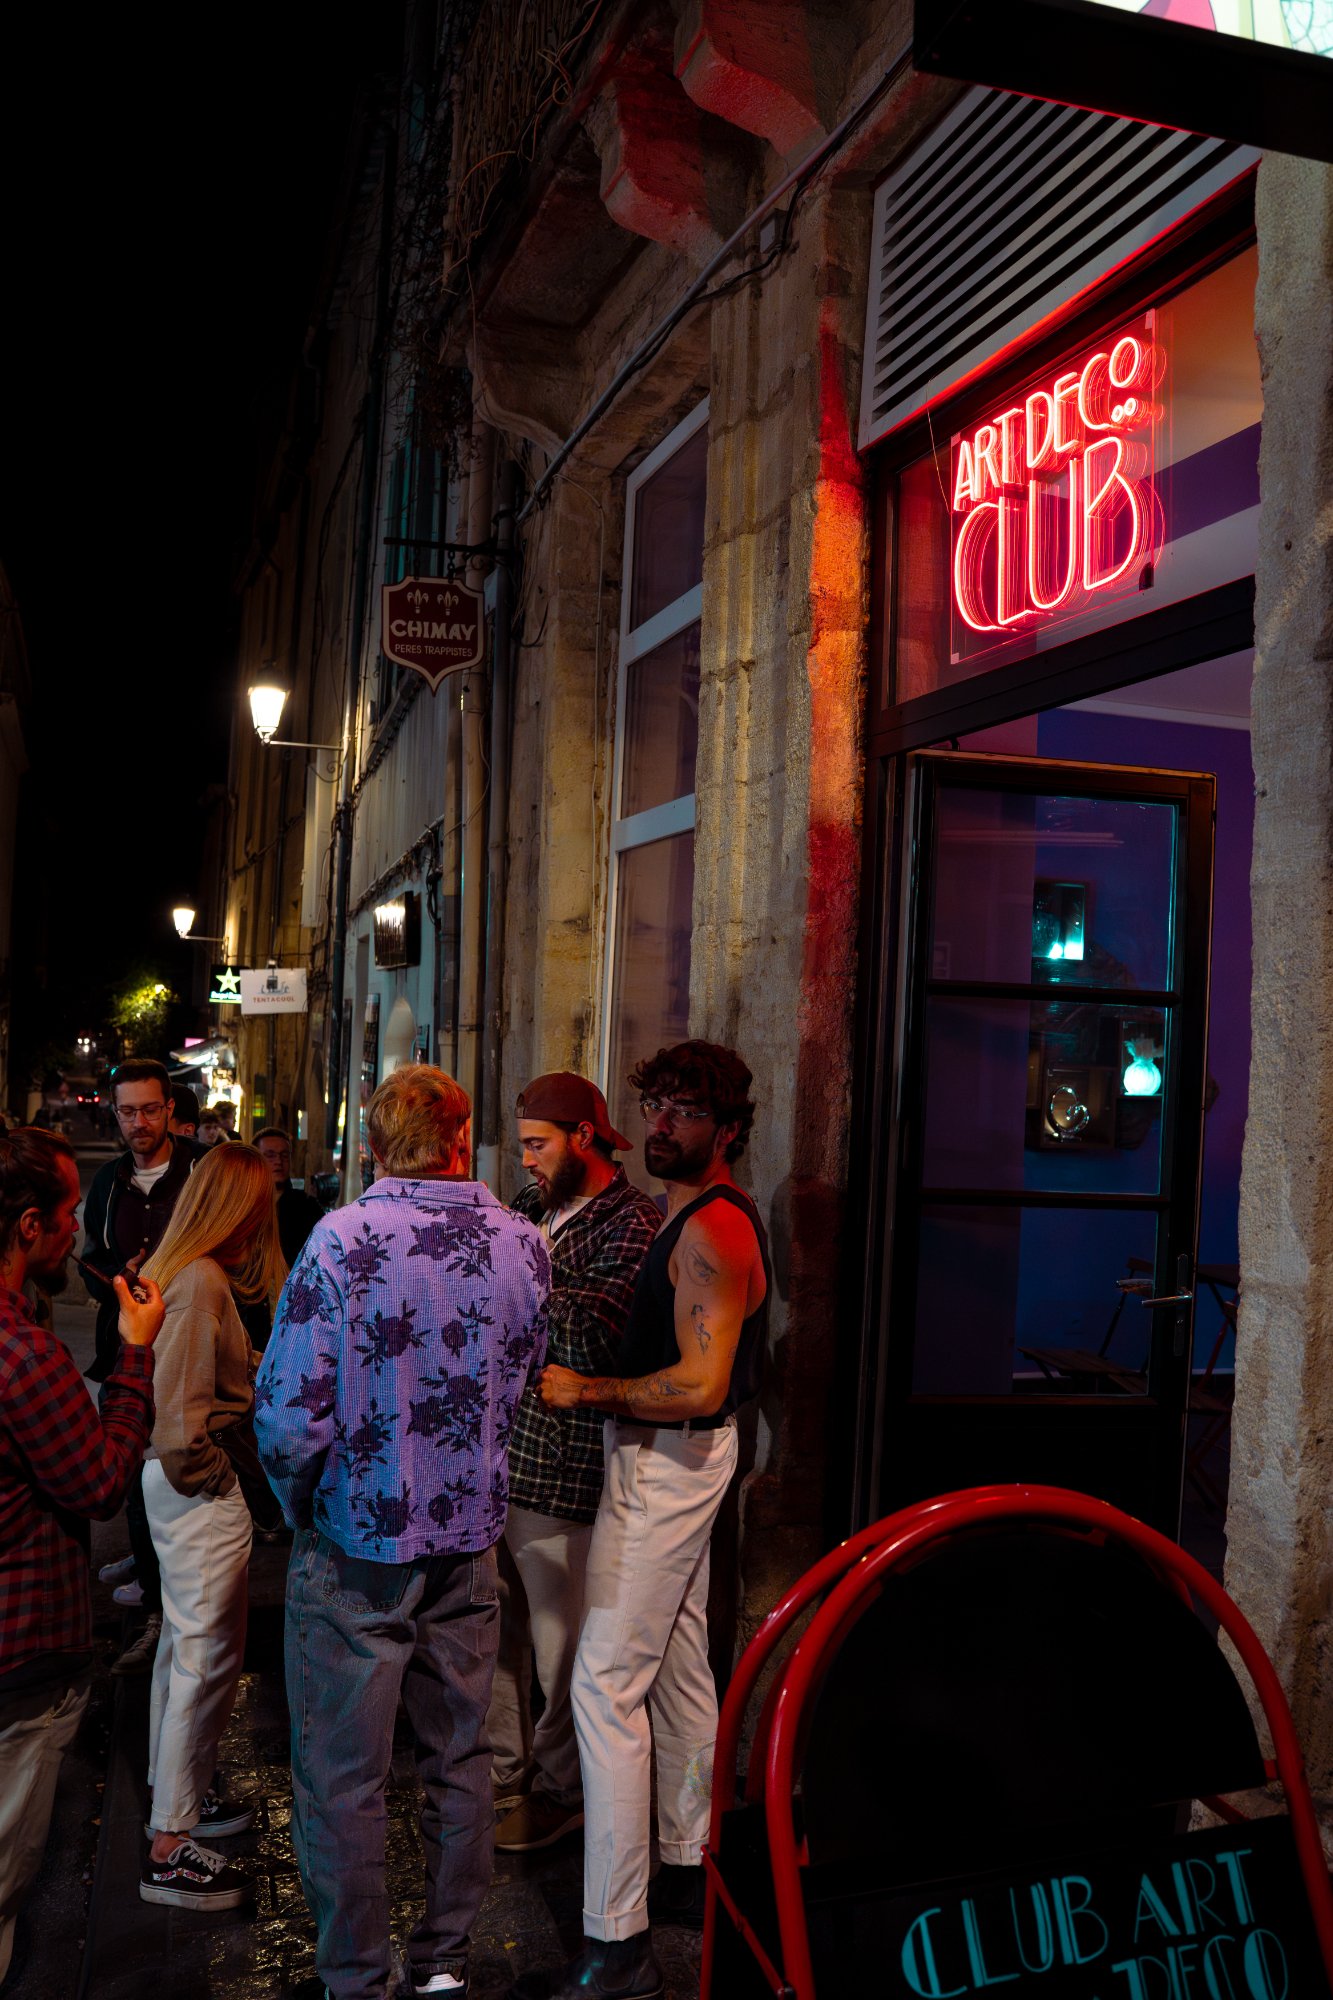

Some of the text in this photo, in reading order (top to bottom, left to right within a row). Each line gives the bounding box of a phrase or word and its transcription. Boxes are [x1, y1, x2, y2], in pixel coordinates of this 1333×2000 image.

[953, 336, 1140, 512] ART DECO
[954, 436, 1139, 632] CLUB
[389, 619, 477, 641] CHIMAY
[394, 643, 473, 658] PERES TRAPPISTES
[901, 1848, 1253, 1999] CLUB ART
